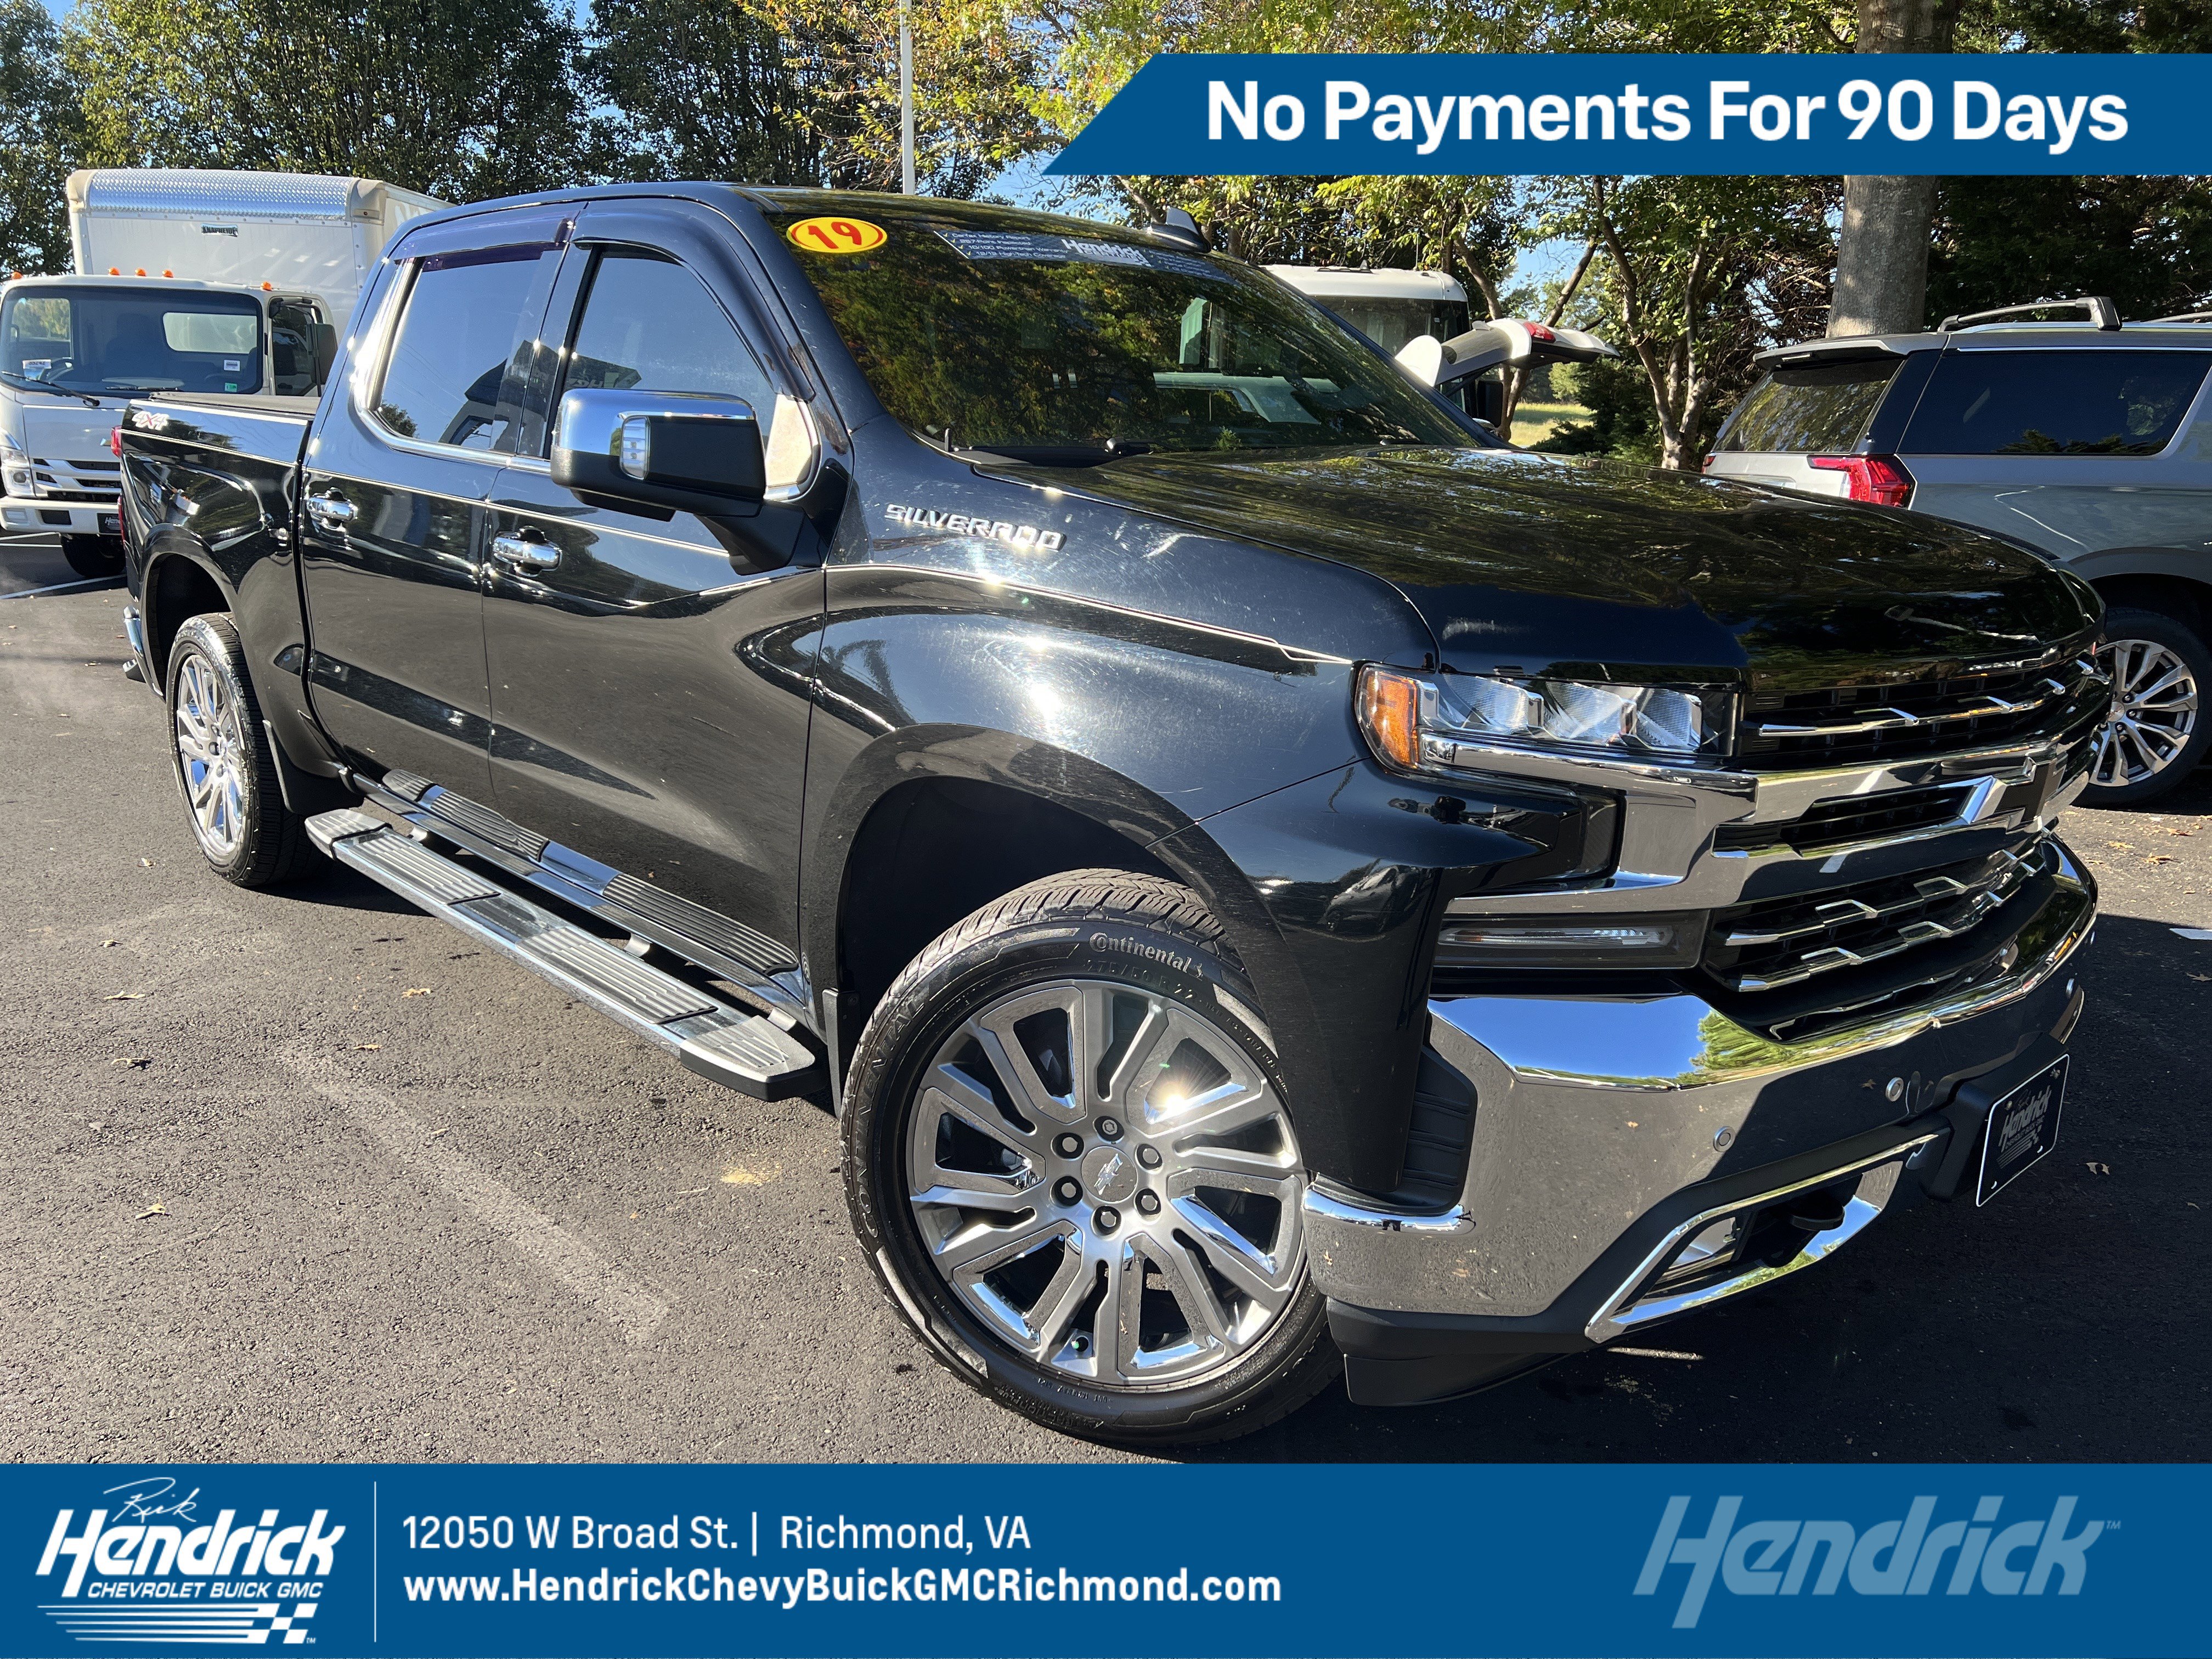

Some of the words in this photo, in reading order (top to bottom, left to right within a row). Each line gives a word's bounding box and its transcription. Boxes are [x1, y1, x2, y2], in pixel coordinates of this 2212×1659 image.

[807, 221, 862, 249] 19
[884, 503, 1069, 551] SILVERADO
[1088, 932, 1192, 974] Continental
